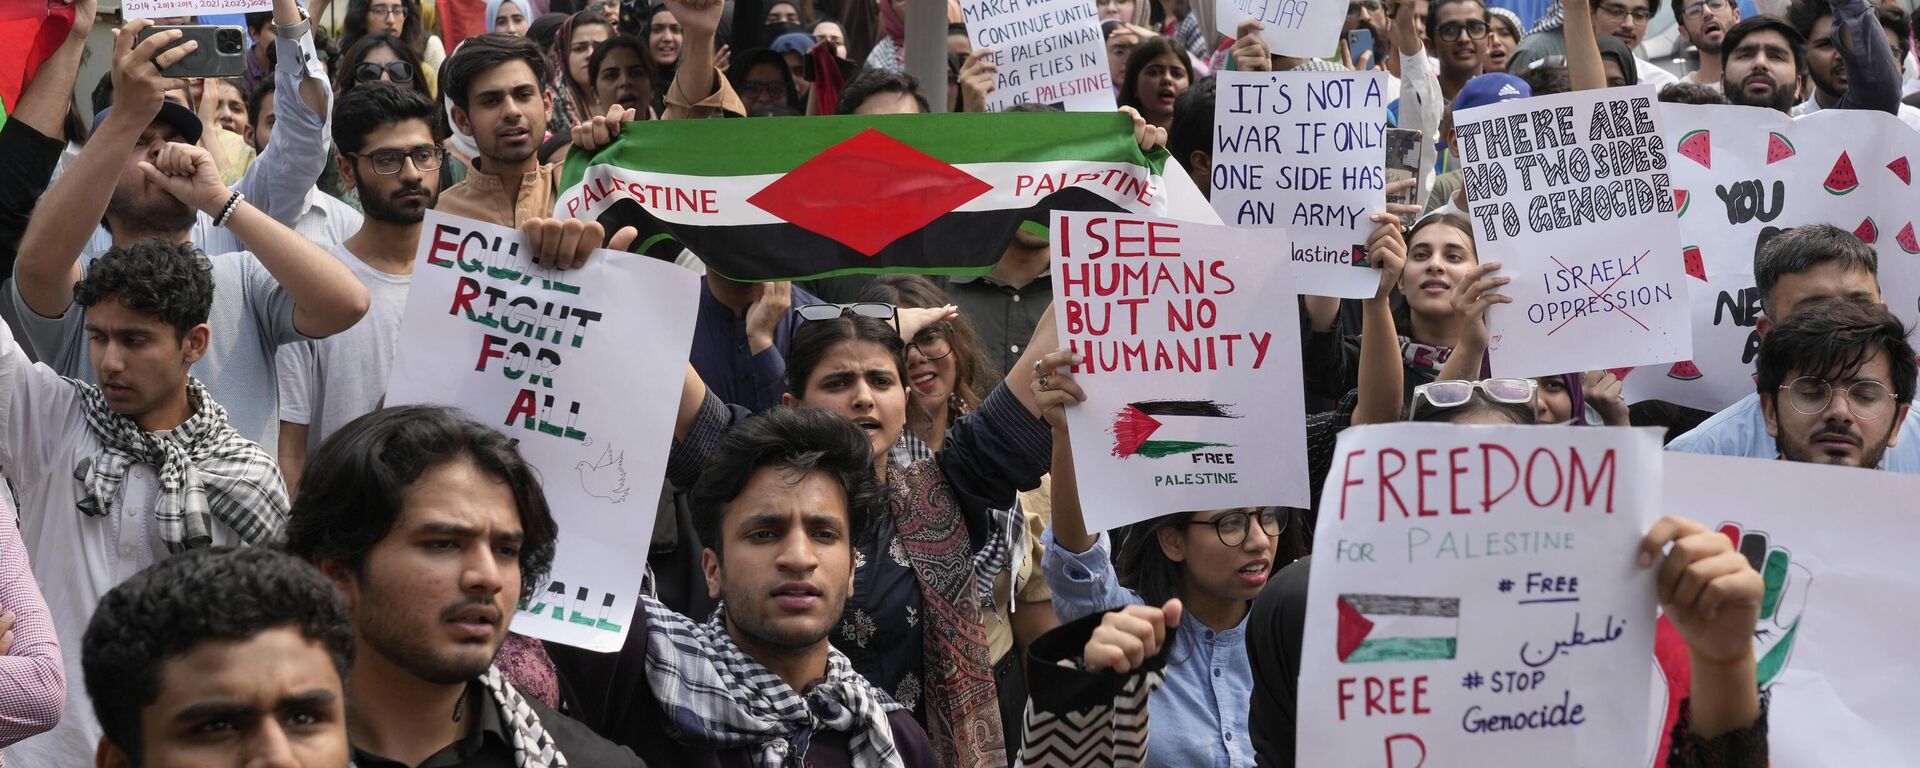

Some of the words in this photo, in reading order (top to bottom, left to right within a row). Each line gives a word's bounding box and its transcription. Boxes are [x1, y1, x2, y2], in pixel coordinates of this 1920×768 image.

[978, 13, 1054, 48] CONTINUE
[1055, 3, 1097, 26] UNTIL
[1011, 26, 1100, 63] PALESTINIAN
[997, 70, 1020, 89] AG
[1030, 55, 1073, 80] FLIES
[1080, 52, 1097, 67] IN
[1036, 72, 1112, 103] PALESTINE
[1229, 76, 1292, 114] IT'S
[1307, 78, 1355, 112] NOT
[1364, 77, 1382, 107] A
[1218, 125, 1282, 154] WAR
[1295, 122, 1327, 154] IF
[1334, 121, 1387, 152] ONLY
[1455, 106, 1577, 163] THERE
[1589, 97, 1655, 141] ARE
[1212, 163, 1264, 190] ONE
[1276, 166, 1332, 191] SIDE
[1342, 166, 1384, 190] HAS
[1463, 161, 1508, 203] NO
[1514, 146, 1591, 191] TWO
[1591, 135, 1667, 179] SIDES
[1237, 200, 1275, 225] AN
[1292, 202, 1365, 230] ARMY
[1474, 201, 1521, 242] TO
[1528, 173, 1674, 233] GENOCIDE
[1715, 179, 1785, 225] YOU
[1060, 216, 1071, 258] I
[1086, 217, 1181, 260] SEE
[1291, 241, 1350, 265] lastine
[427, 224, 581, 296] EQUAL
[1062, 260, 1236, 297] HUMANS
[1544, 256, 1640, 294] ISRAELI
[449, 276, 603, 349] RIGHT
[1066, 298, 1149, 335] BUT
[1168, 298, 1217, 332] NO
[1527, 283, 1673, 324] OPPRESSION
[475, 333, 562, 389] FOR
[1069, 332, 1272, 374] HUMANITY
[1192, 452, 1235, 465] FREE
[1155, 472, 1238, 487] PALESTINE
[1339, 443, 1617, 523] FREEDOM
[1336, 539, 1376, 563] FOR
[1408, 526, 1576, 563] PALESTINE
[1526, 572, 1580, 593] FREE
[1337, 675, 1431, 721] FREE
[1491, 670, 1546, 693] STOP
[1462, 689, 1587, 734] Genocide
